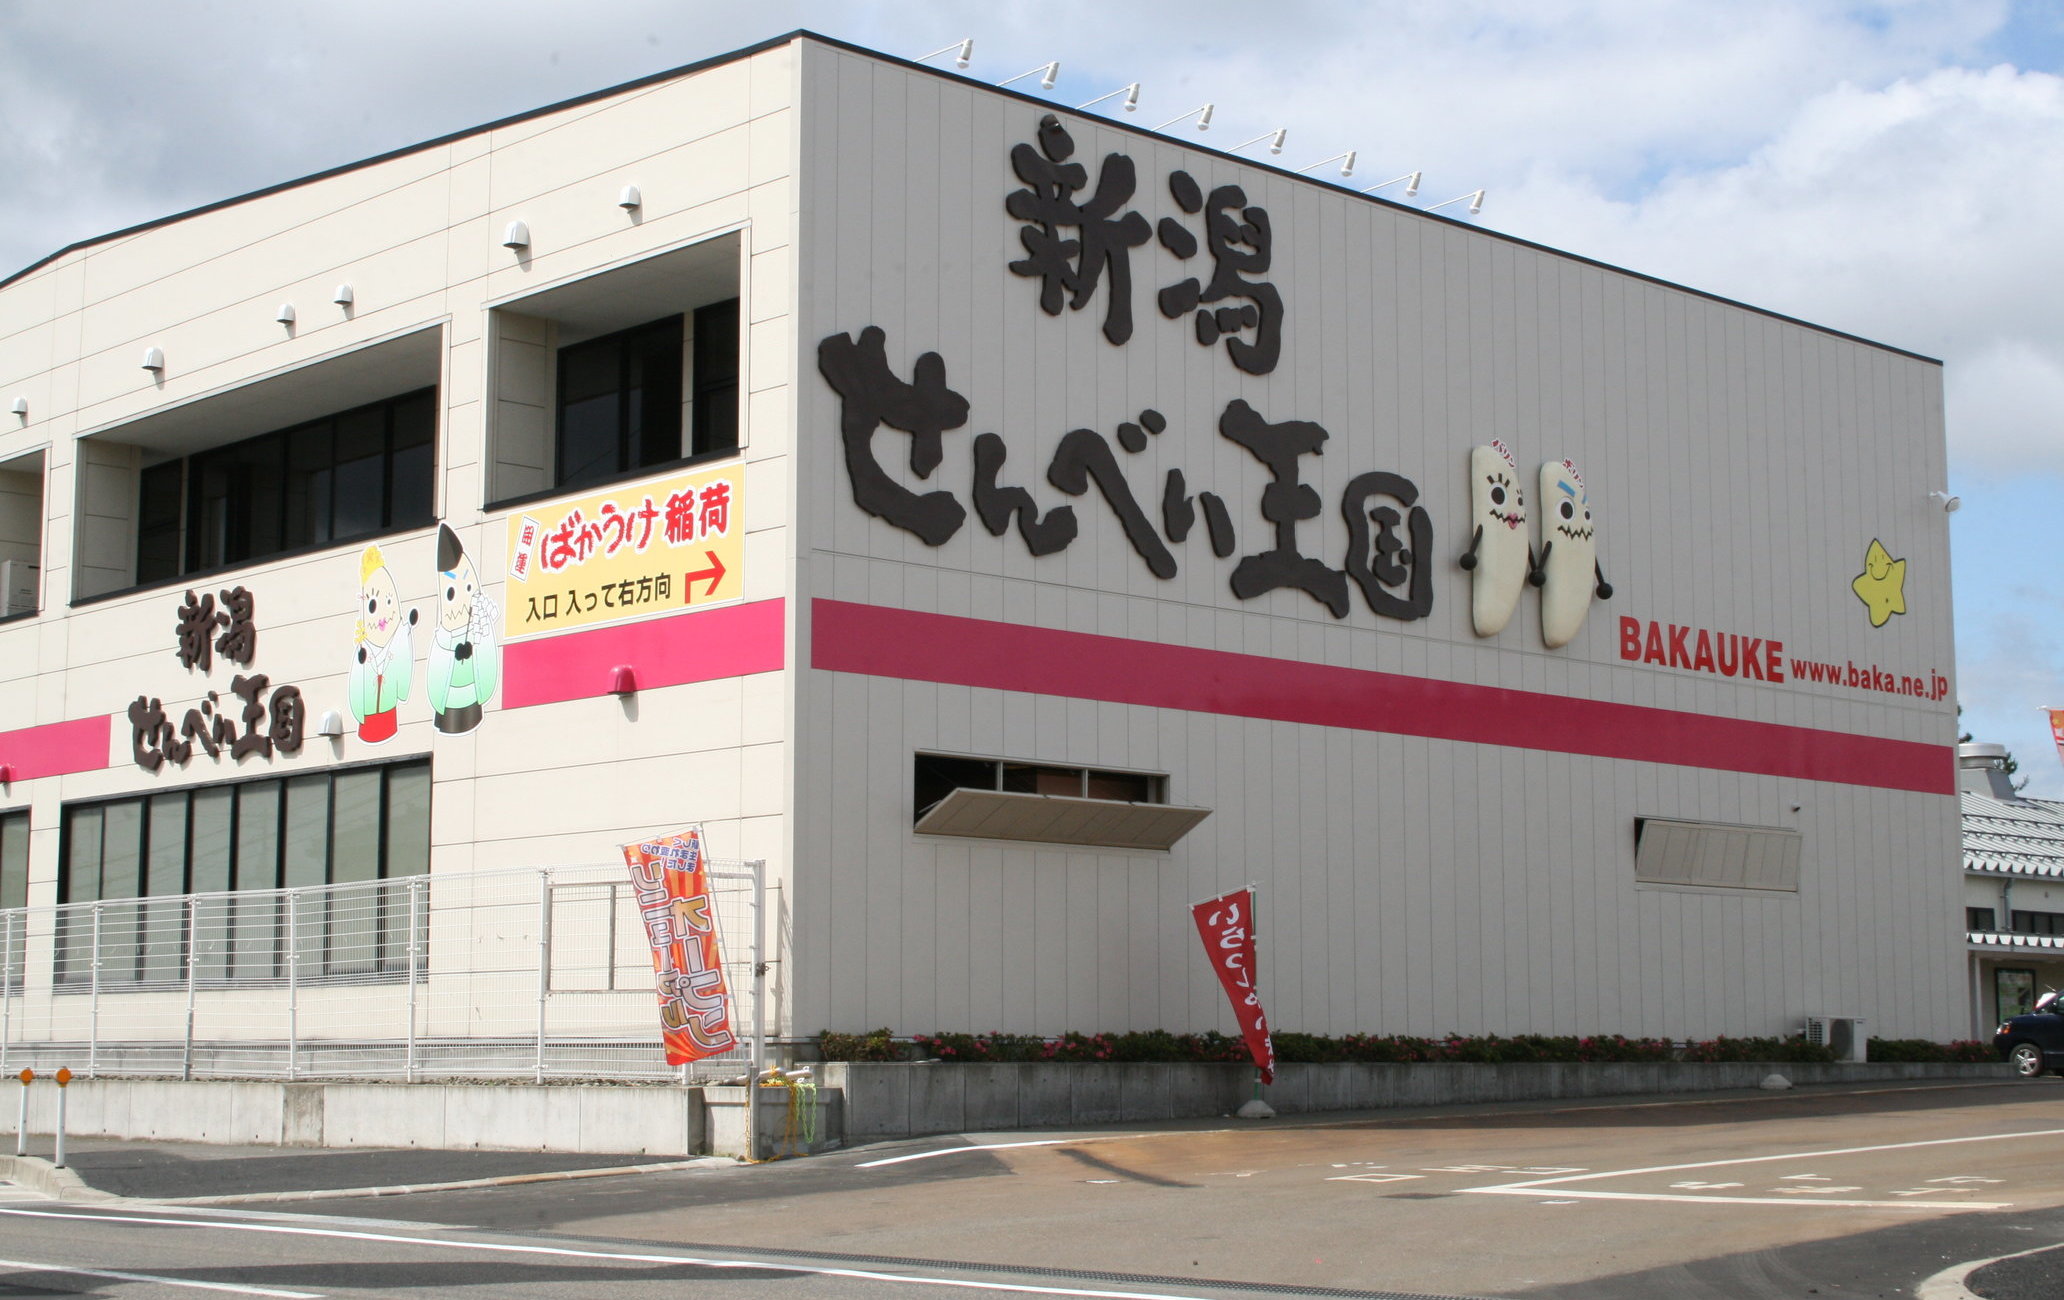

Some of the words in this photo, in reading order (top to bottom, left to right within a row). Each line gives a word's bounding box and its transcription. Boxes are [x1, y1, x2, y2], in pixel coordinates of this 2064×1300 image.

[1006, 114, 1283, 375] 新潟
[818, 326, 1433, 620] せんべい王国
[541, 482, 731, 570] ばかうけ稲荷
[176, 586, 256, 671] 新潟
[526, 594, 558, 622] 入口
[566, 572, 671, 616] 入って右方向
[1619, 615, 1784, 683] BAKAUKE
[1790, 659, 1948, 701] www.baka.ne.jp
[128, 674, 306, 771] せんべい王国
